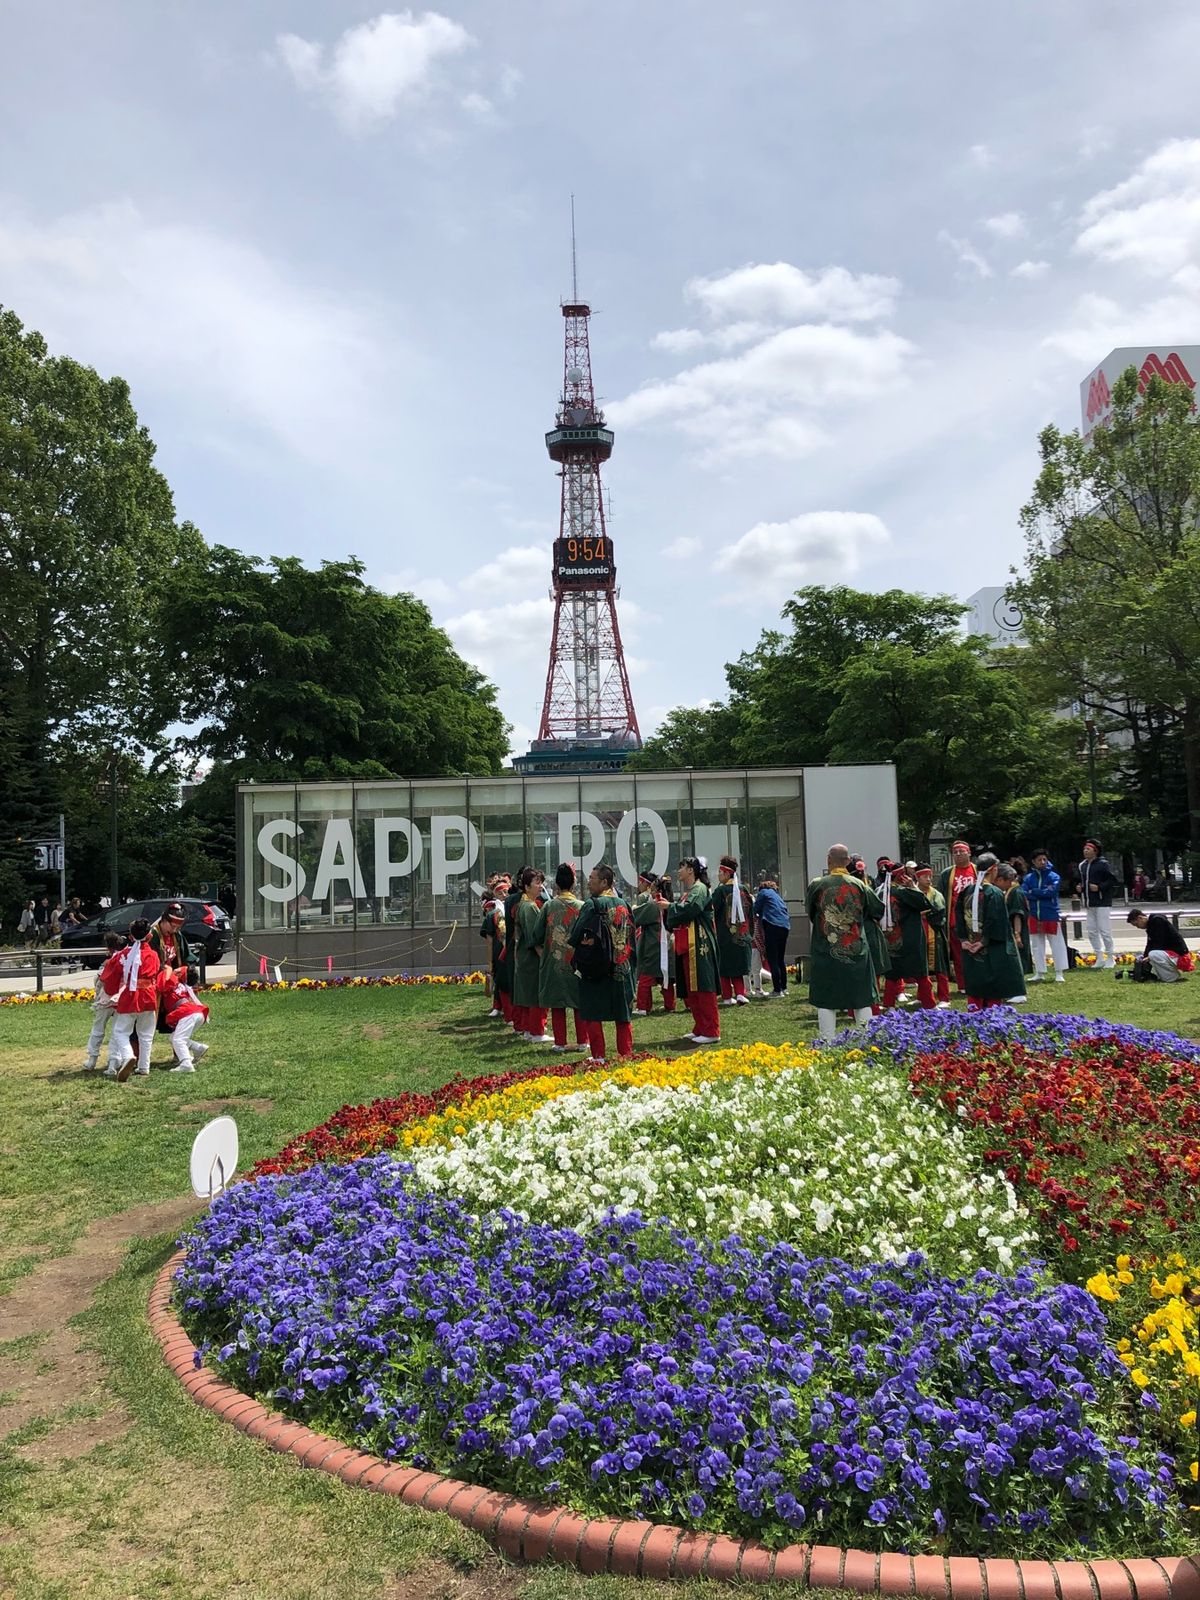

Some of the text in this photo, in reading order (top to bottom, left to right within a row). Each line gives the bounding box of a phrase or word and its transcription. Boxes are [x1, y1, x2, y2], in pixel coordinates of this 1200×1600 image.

[568, 538, 605, 561] 9:54
[559, 565, 609, 575] Panasonic
[257, 807, 669, 902] SAPPRO
